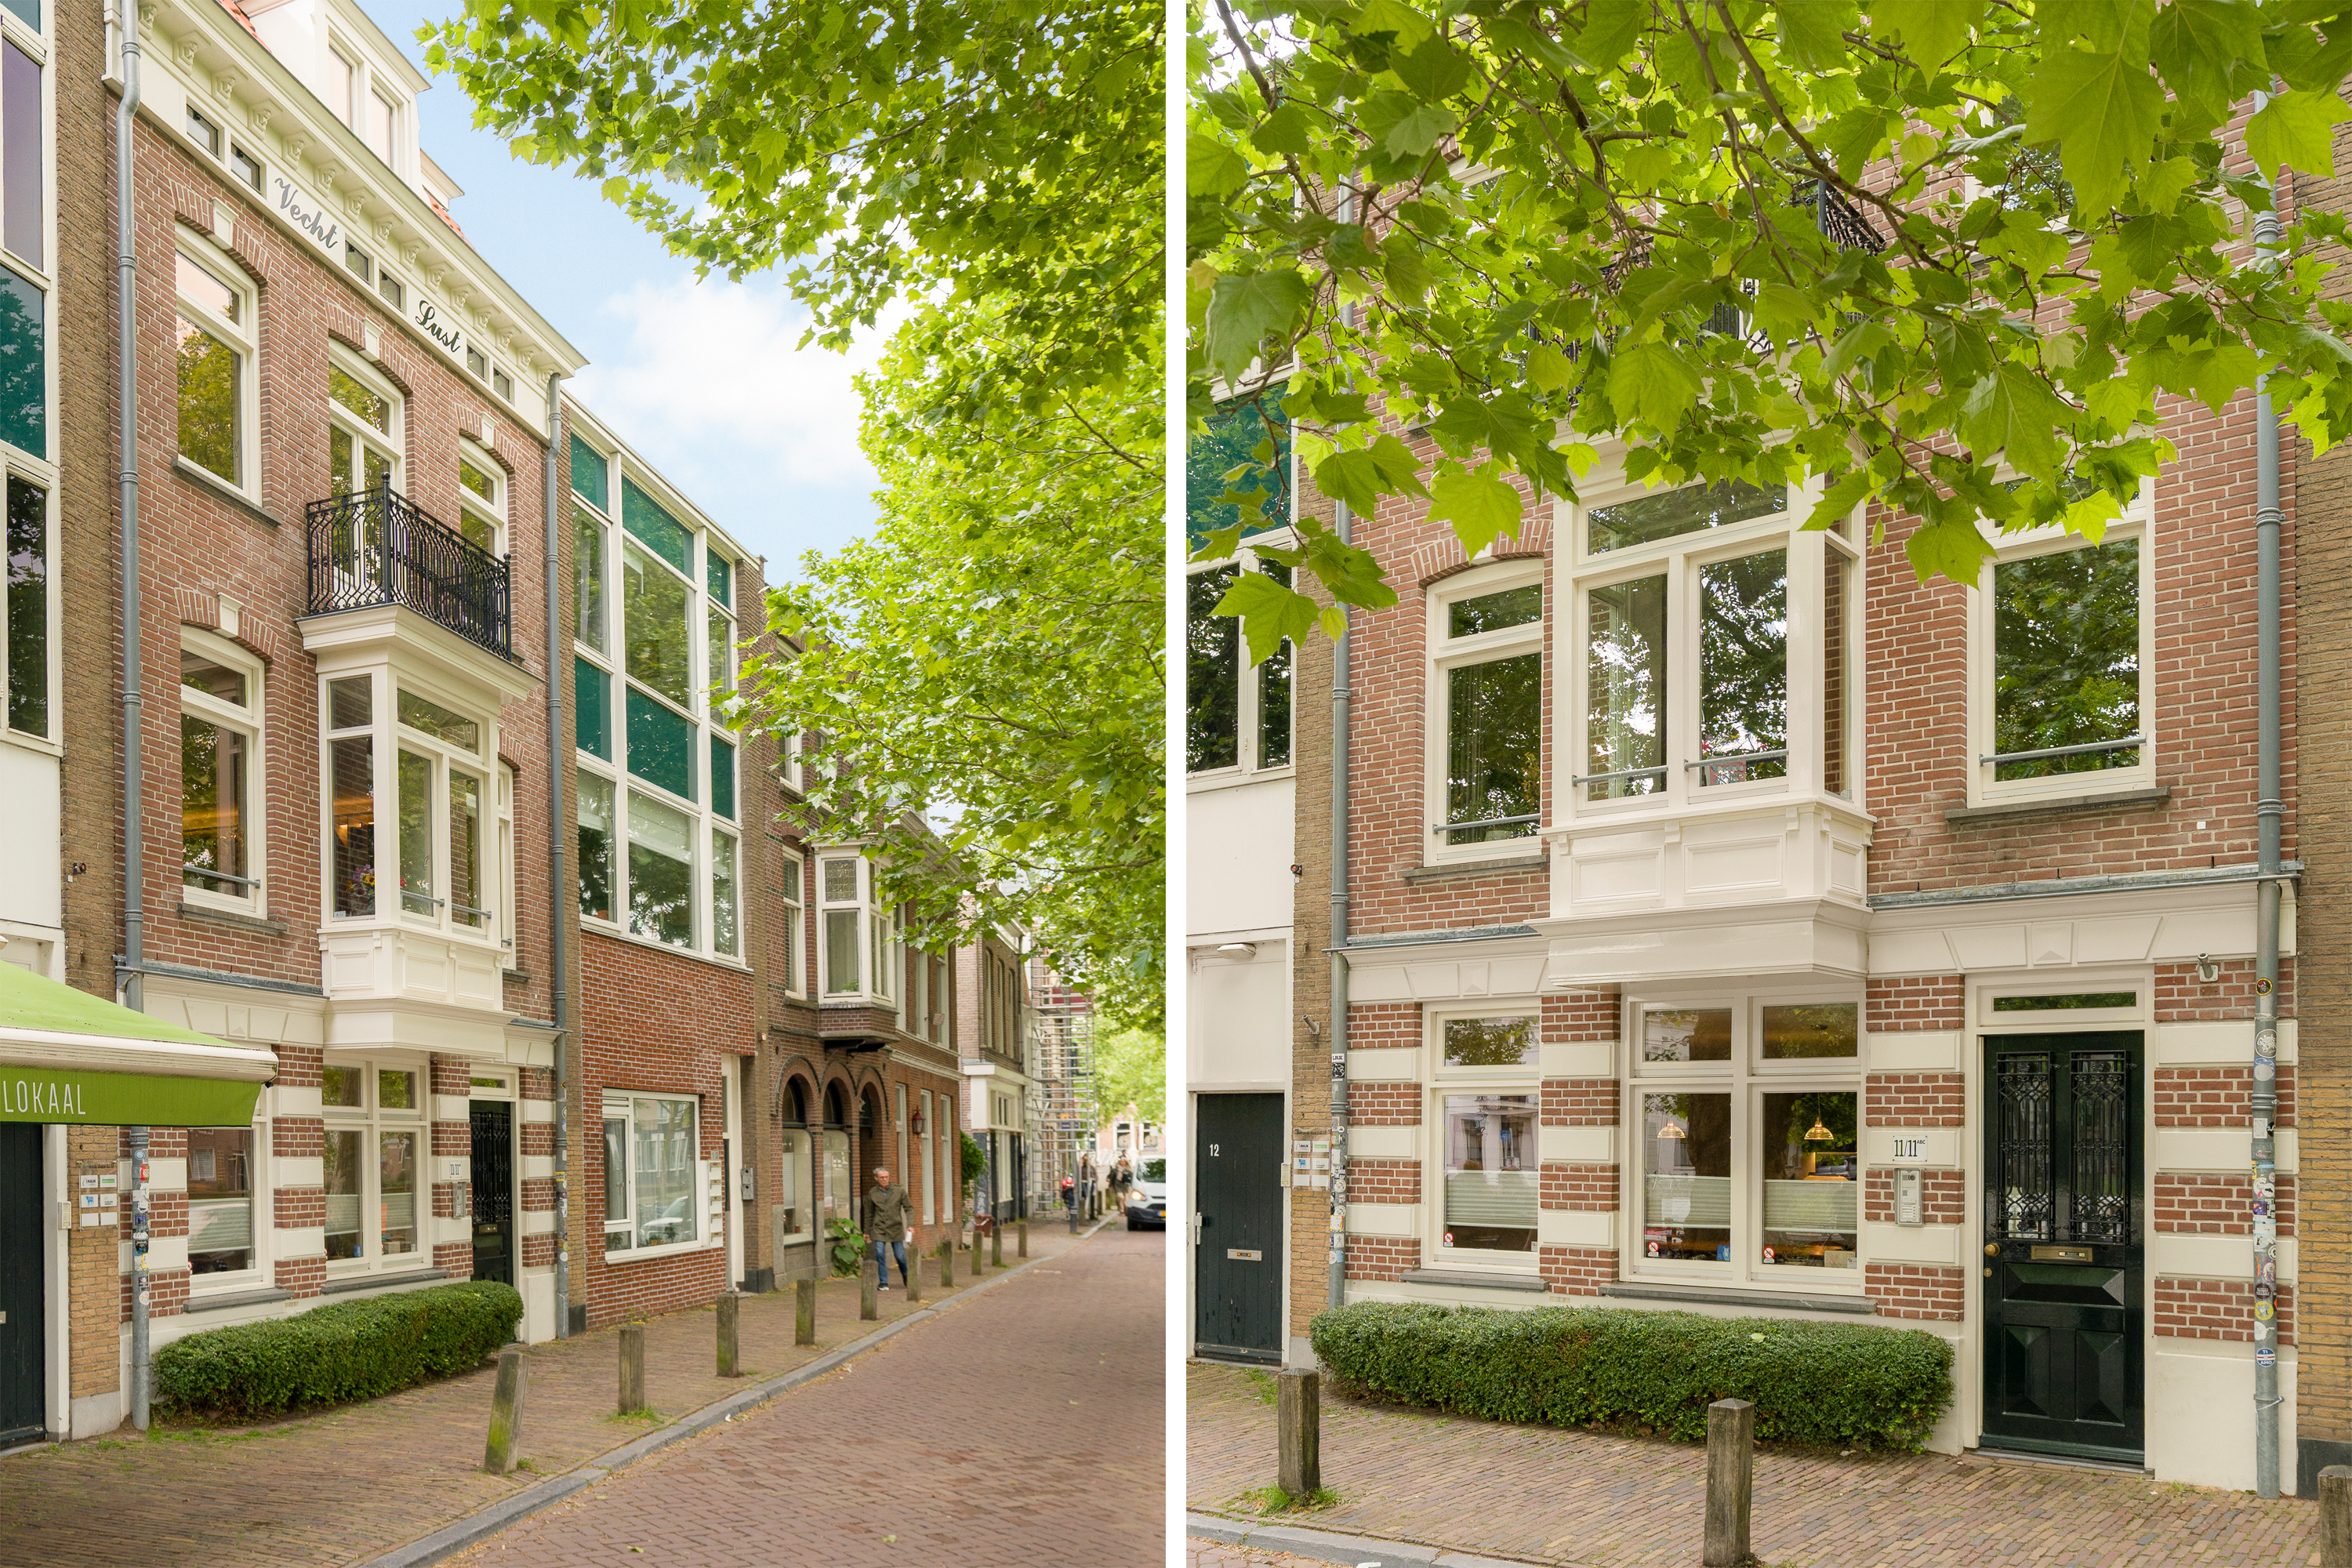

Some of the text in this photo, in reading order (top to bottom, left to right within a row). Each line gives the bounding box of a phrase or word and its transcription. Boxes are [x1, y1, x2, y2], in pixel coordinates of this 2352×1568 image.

[274, 177, 338, 249] Vecht
[416, 299, 461, 353] Lust
[3, 1080, 86, 1115] LOKAAL
[1210, 1144, 1219, 1156] 12
